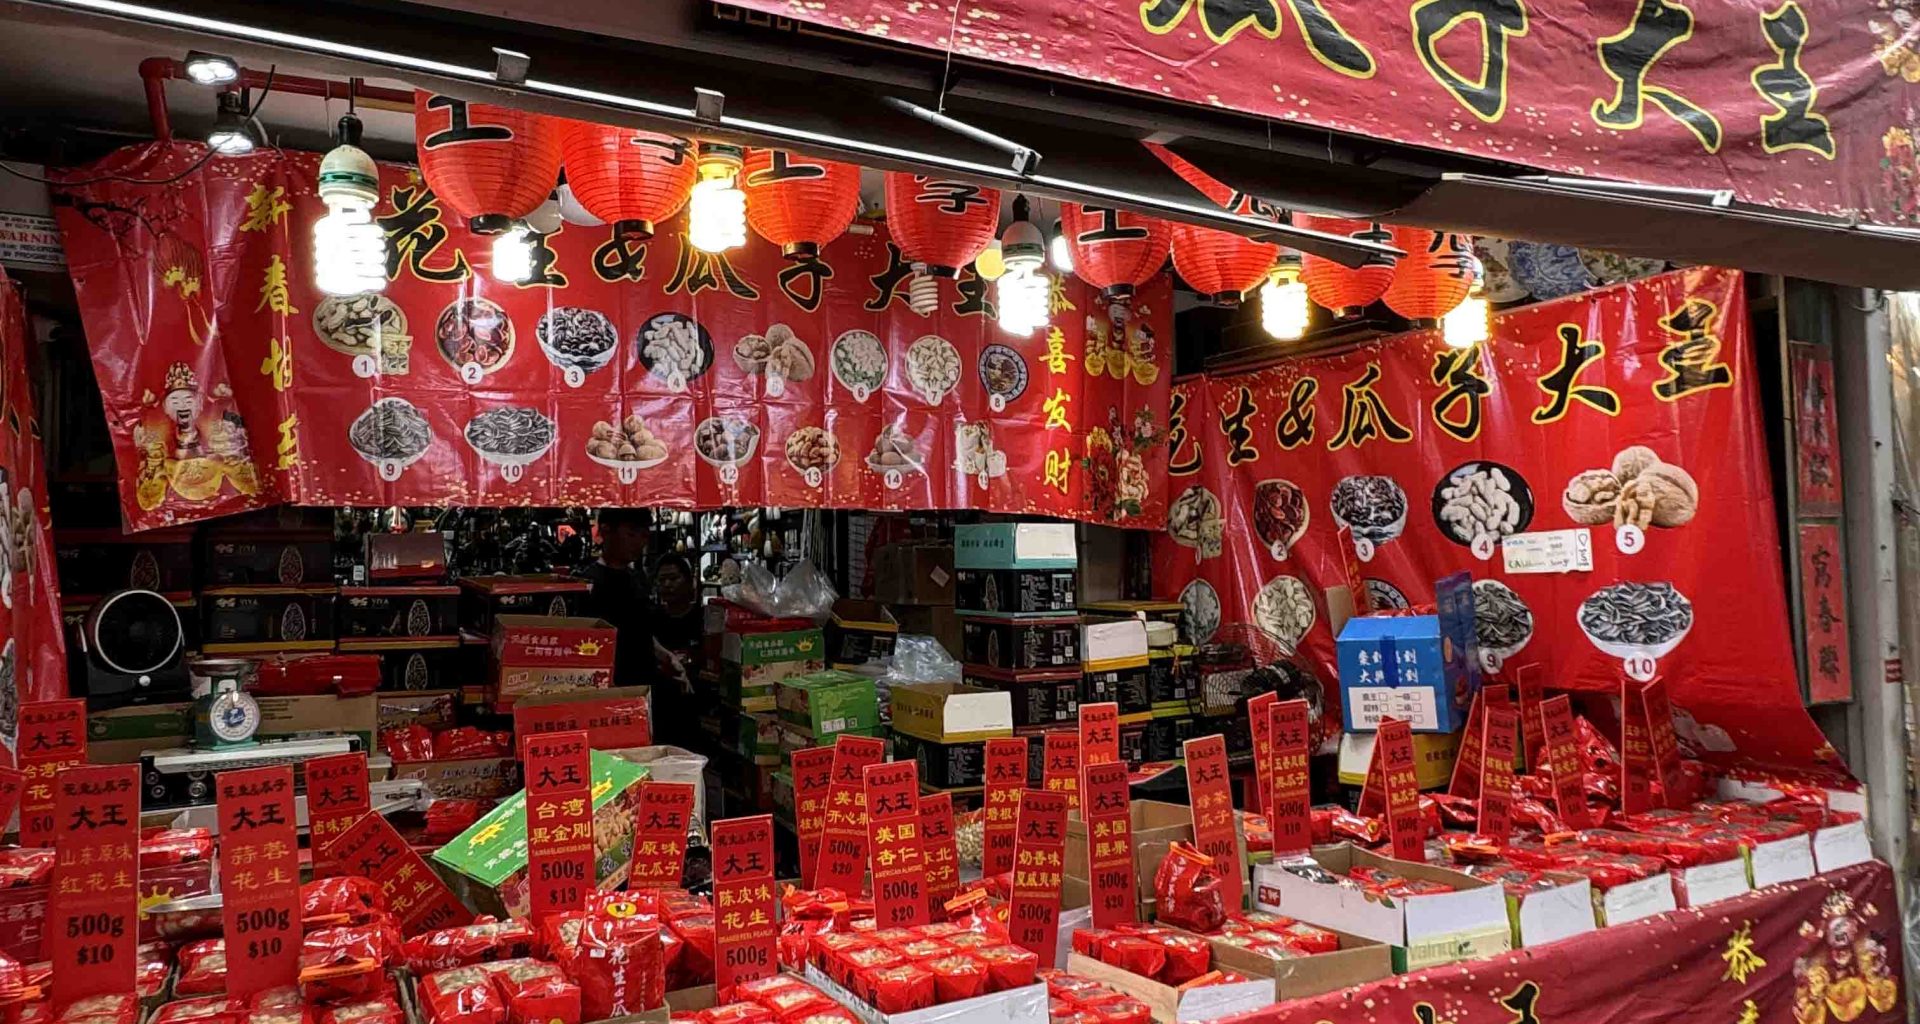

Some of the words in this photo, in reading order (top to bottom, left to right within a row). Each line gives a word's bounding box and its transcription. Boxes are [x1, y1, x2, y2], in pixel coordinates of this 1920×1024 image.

[360, 359, 369, 373] 1
[467, 366, 477, 381] 2
[569, 369, 579, 384] 3
[671, 376, 682, 390] 4
[856, 386, 866, 400] 6
[929, 389, 940, 403] 7
[992, 397, 1002, 411] 8
[384, 462, 396, 477] 9
[501, 464, 521, 479] 10
[617, 467, 635, 480] 11
[719, 466, 738, 482] 12
[803, 470, 823, 485] 13
[883, 471, 902, 487] 14
[1478, 540, 1490, 555] 4
[1623, 530, 1635, 547] 5
[1275, 544, 1286, 558] 2
[1359, 543, 1370, 558] 3
[1487, 654, 1496, 668] 9
[1628, 659, 1653, 675] 10
[31, 730, 77, 752] 大王
[1086, 727, 1114, 745] 大王
[1276, 728, 1303, 746] 大王
[1050, 755, 1077, 770] 大王
[1390, 746, 1410, 763] 大王
[536, 763, 583, 789] 大王
[993, 761, 1022, 779] 大王
[1195, 762, 1224, 784] 大王
[802, 770, 830, 791] 大王
[317, 784, 361, 808] 大王
[875, 792, 913, 815] 大王
[1094, 791, 1125, 810] 大王
[230, 802, 286, 832] 大王
[535, 797, 587, 821] 台湾
[827, 808, 872, 826] 开心果
[1279, 799, 1305, 817] 500g
[68, 803, 129, 832] 大王
[644, 811, 683, 831] 大王
[1199, 809, 1230, 828] 瓜子
[529, 820, 592, 845] 黑金刚
[1025, 820, 1060, 839] 大王
[638, 839, 681, 857] 原味
[828, 840, 863, 861] 500g
[991, 833, 1014, 850] 500
[1205, 839, 1233, 856] 500g
[60, 845, 133, 868] 山东原味
[722, 851, 766, 876] 大王
[876, 847, 919, 866] 杏仁
[1018, 849, 1061, 866] 奶香味
[540, 858, 586, 881] 500g
[632, 860, 680, 878] 红瓜子
[831, 862, 854, 876] $20
[59, 871, 133, 895] 红花生
[230, 866, 293, 893] 花生
[1015, 870, 1061, 888] 夏威夷果
[1098, 872, 1129, 889] 500g
[550, 886, 579, 906] $13
[718, 883, 773, 907] 陈皮味
[882, 881, 920, 901] 500g
[891, 905, 915, 922] $20
[1104, 898, 1124, 911] $20
[235, 907, 291, 934] 500g
[721, 909, 770, 931] 花生
[1018, 904, 1051, 924] 500g
[66, 911, 124, 938] 500g
[1022, 928, 1044, 943] $20
[76, 942, 115, 965] $10
[247, 937, 283, 960] $10
[725, 945, 768, 968] 500g
